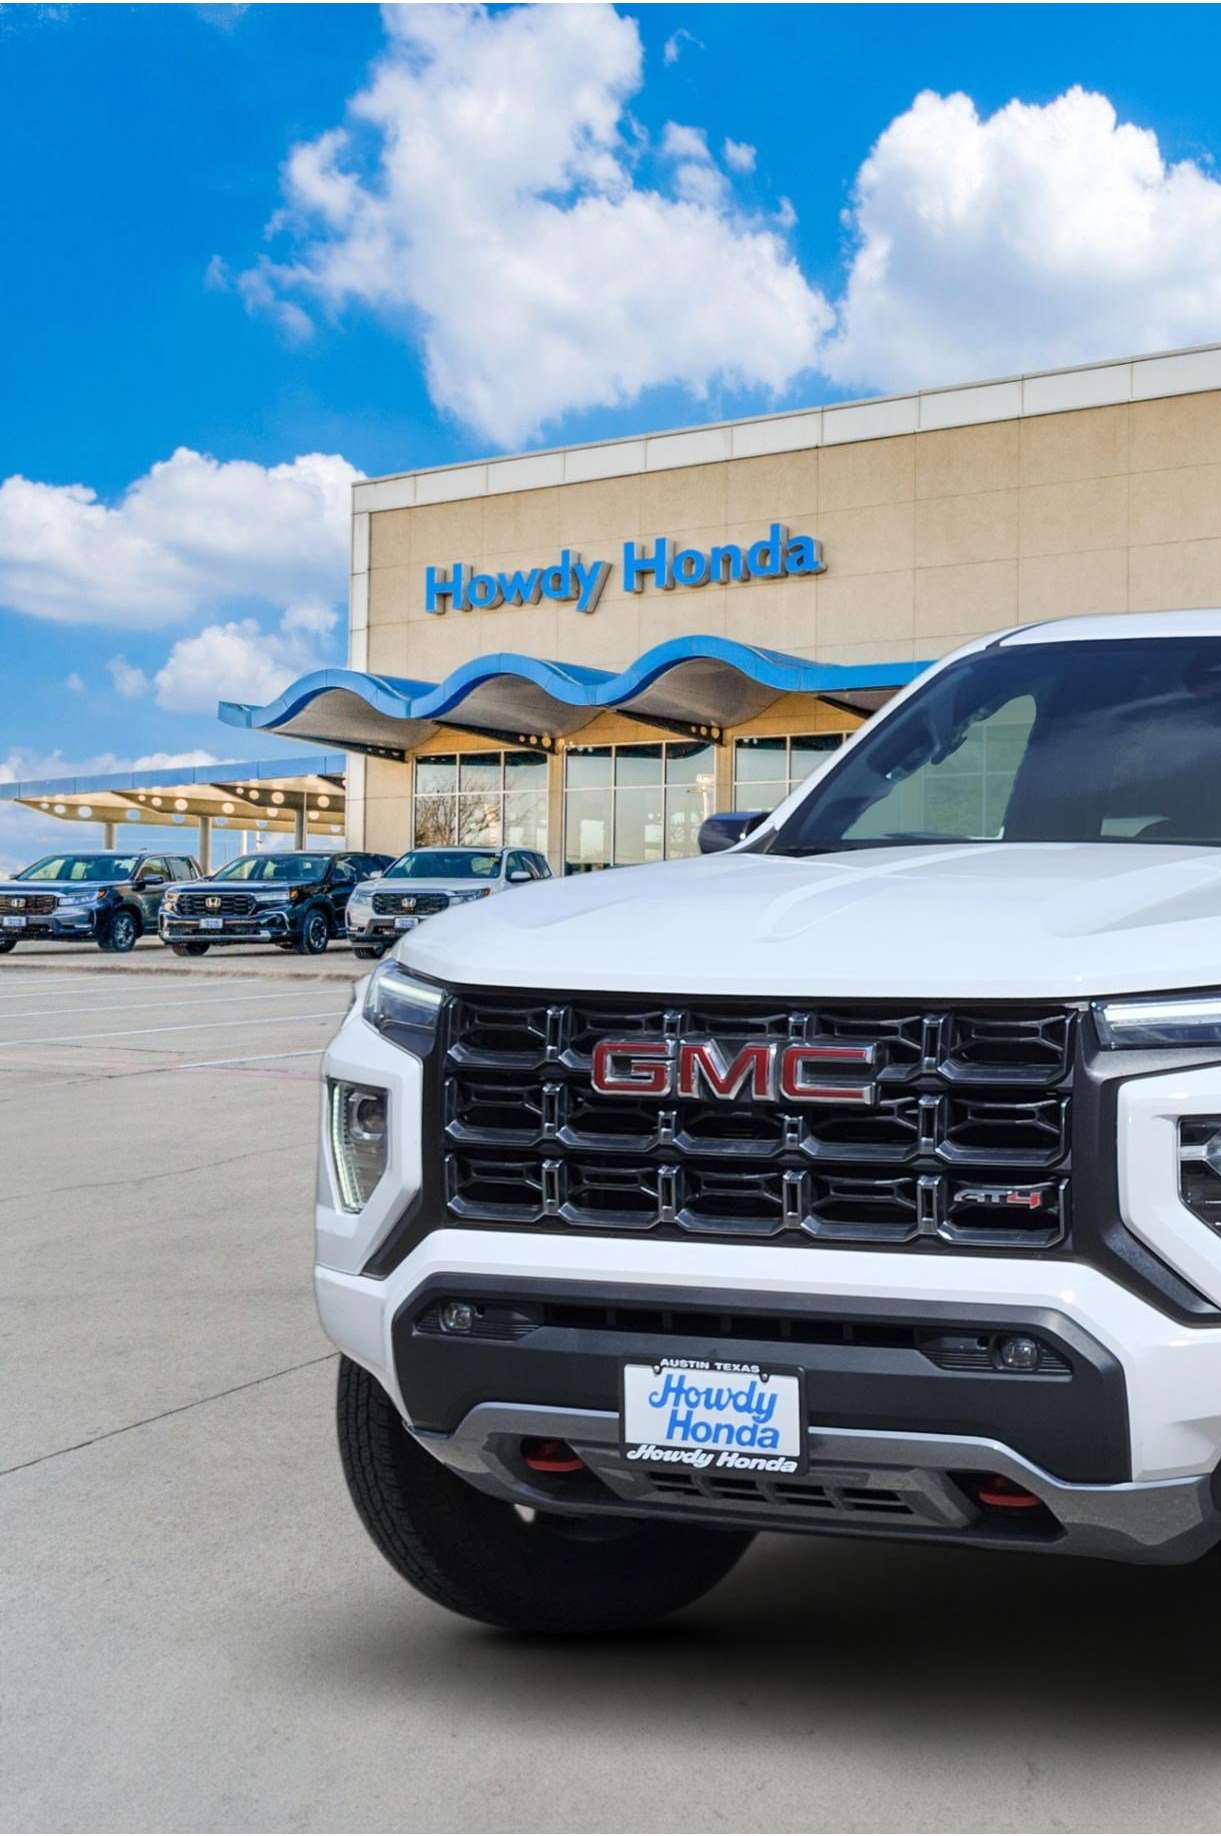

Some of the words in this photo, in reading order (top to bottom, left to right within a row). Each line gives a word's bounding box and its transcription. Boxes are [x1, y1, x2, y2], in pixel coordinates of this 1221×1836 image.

[425, 548, 612, 615] Howdy
[623, 523, 827, 593] Honda
[591, 1038, 879, 1105] GMC
[953, 1188, 1042, 1210] AT4
[660, 1358, 710, 1370] AUSTIN
[714, 1362, 760, 1374] TEXAS
[648, 1374, 778, 1424] Howdy
[666, 1409, 780, 1449] Honda
[626, 1444, 715, 1468] Howdy
[716, 1451, 799, 1474] Honda
